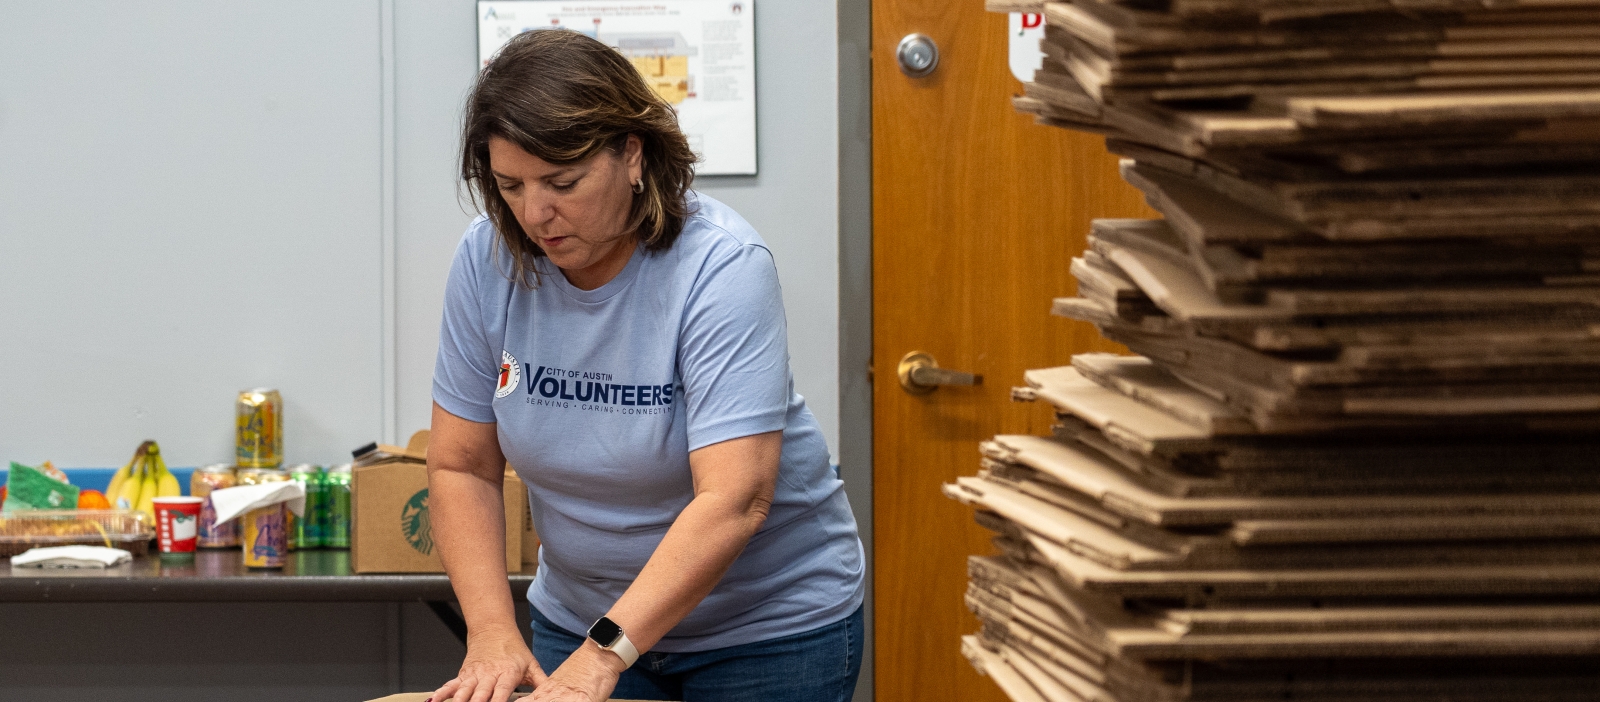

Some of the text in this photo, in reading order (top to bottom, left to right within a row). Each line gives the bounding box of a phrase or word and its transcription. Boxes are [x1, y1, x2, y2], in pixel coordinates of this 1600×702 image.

[524, 362, 673, 406] VOLUNTEERS
[546, 367, 613, 382] CITY OF AUSTIN
[526, 396, 673, 416] SERVING CARING CONNECTIN
